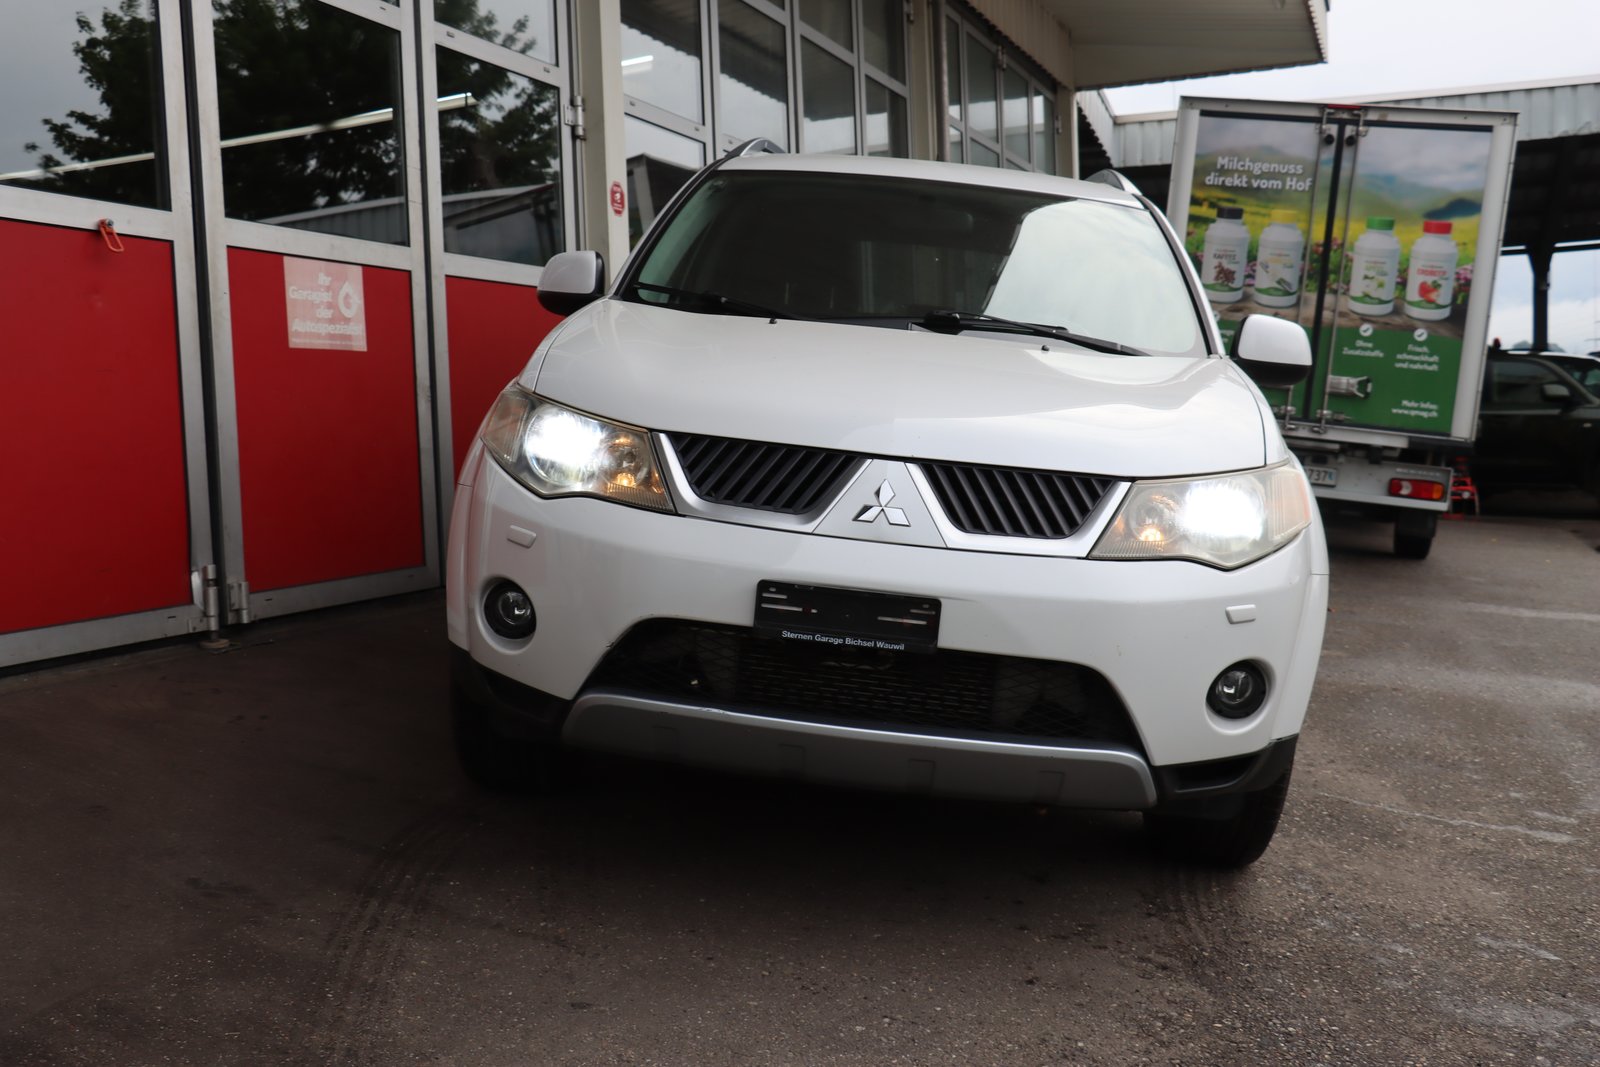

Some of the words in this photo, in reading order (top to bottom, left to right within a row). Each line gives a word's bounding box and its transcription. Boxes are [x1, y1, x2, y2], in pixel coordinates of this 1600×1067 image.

[1217, 157, 1303, 174] Milchgenuss
[1205, 173, 1248, 187] direkt
[1252, 179, 1282, 189] vom
[1286, 177, 1312, 191] Hof
[316, 305, 333, 318] der
[781, 630, 813, 641] Sternen
[814, 634, 844, 645] Garage
[845, 637, 875, 648] Bichsel
[876, 641, 905, 651] Wauwil
